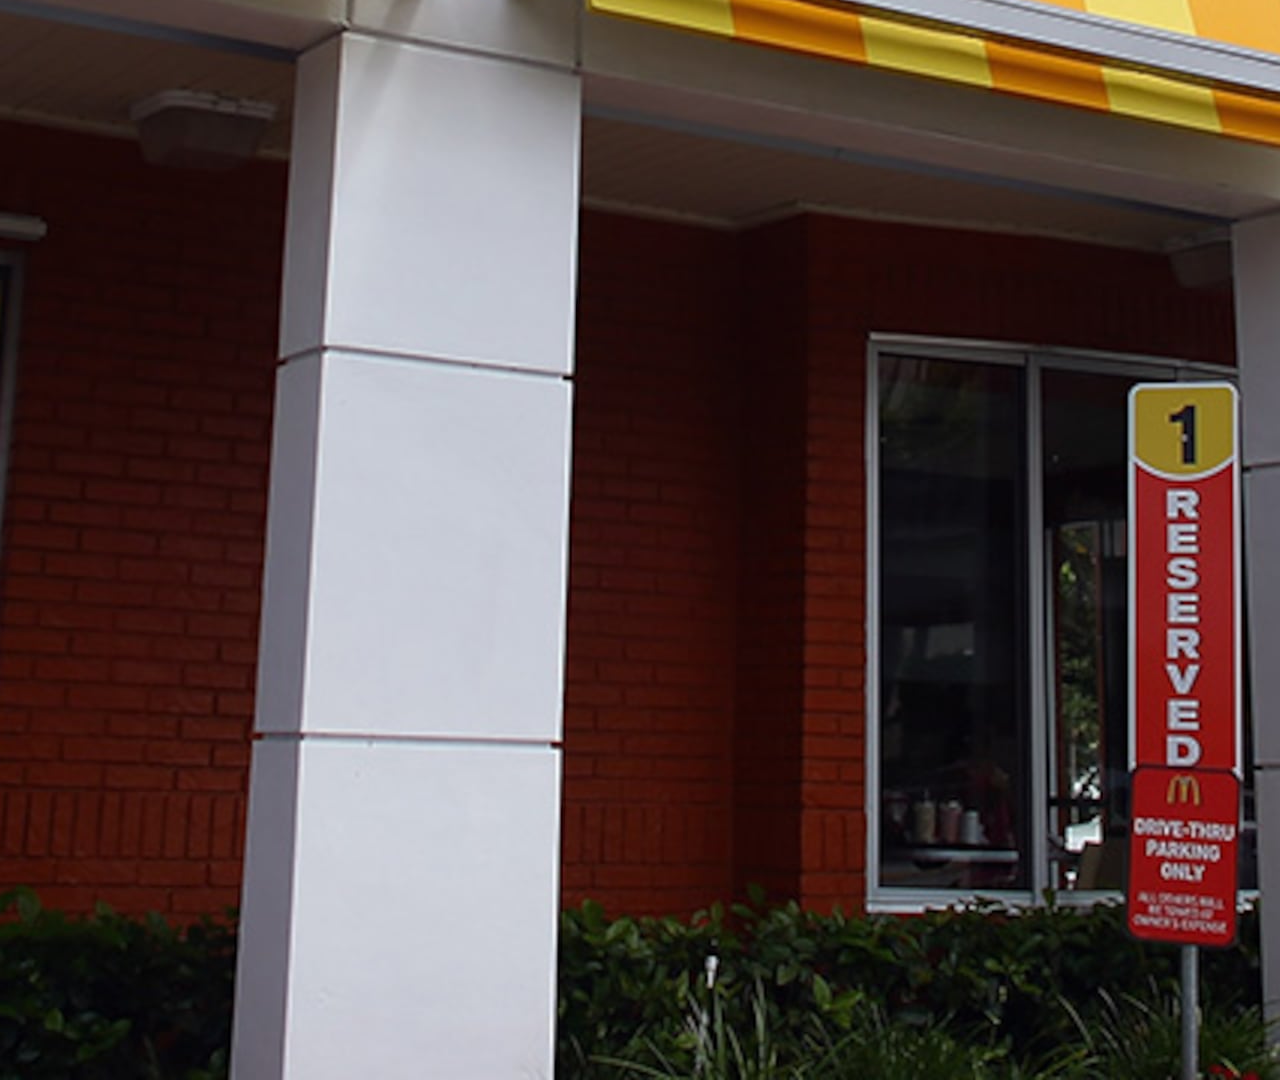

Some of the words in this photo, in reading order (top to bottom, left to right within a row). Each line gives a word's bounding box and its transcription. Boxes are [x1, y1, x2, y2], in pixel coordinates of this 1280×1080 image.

[1167, 404, 1199, 465] 1
[1165, 488, 1202, 768] RESERVED
[1133, 817, 1236, 842] DRIVE-THRU
[1145, 838, 1221, 863] PARKING
[1160, 861, 1206, 882] ONLY
